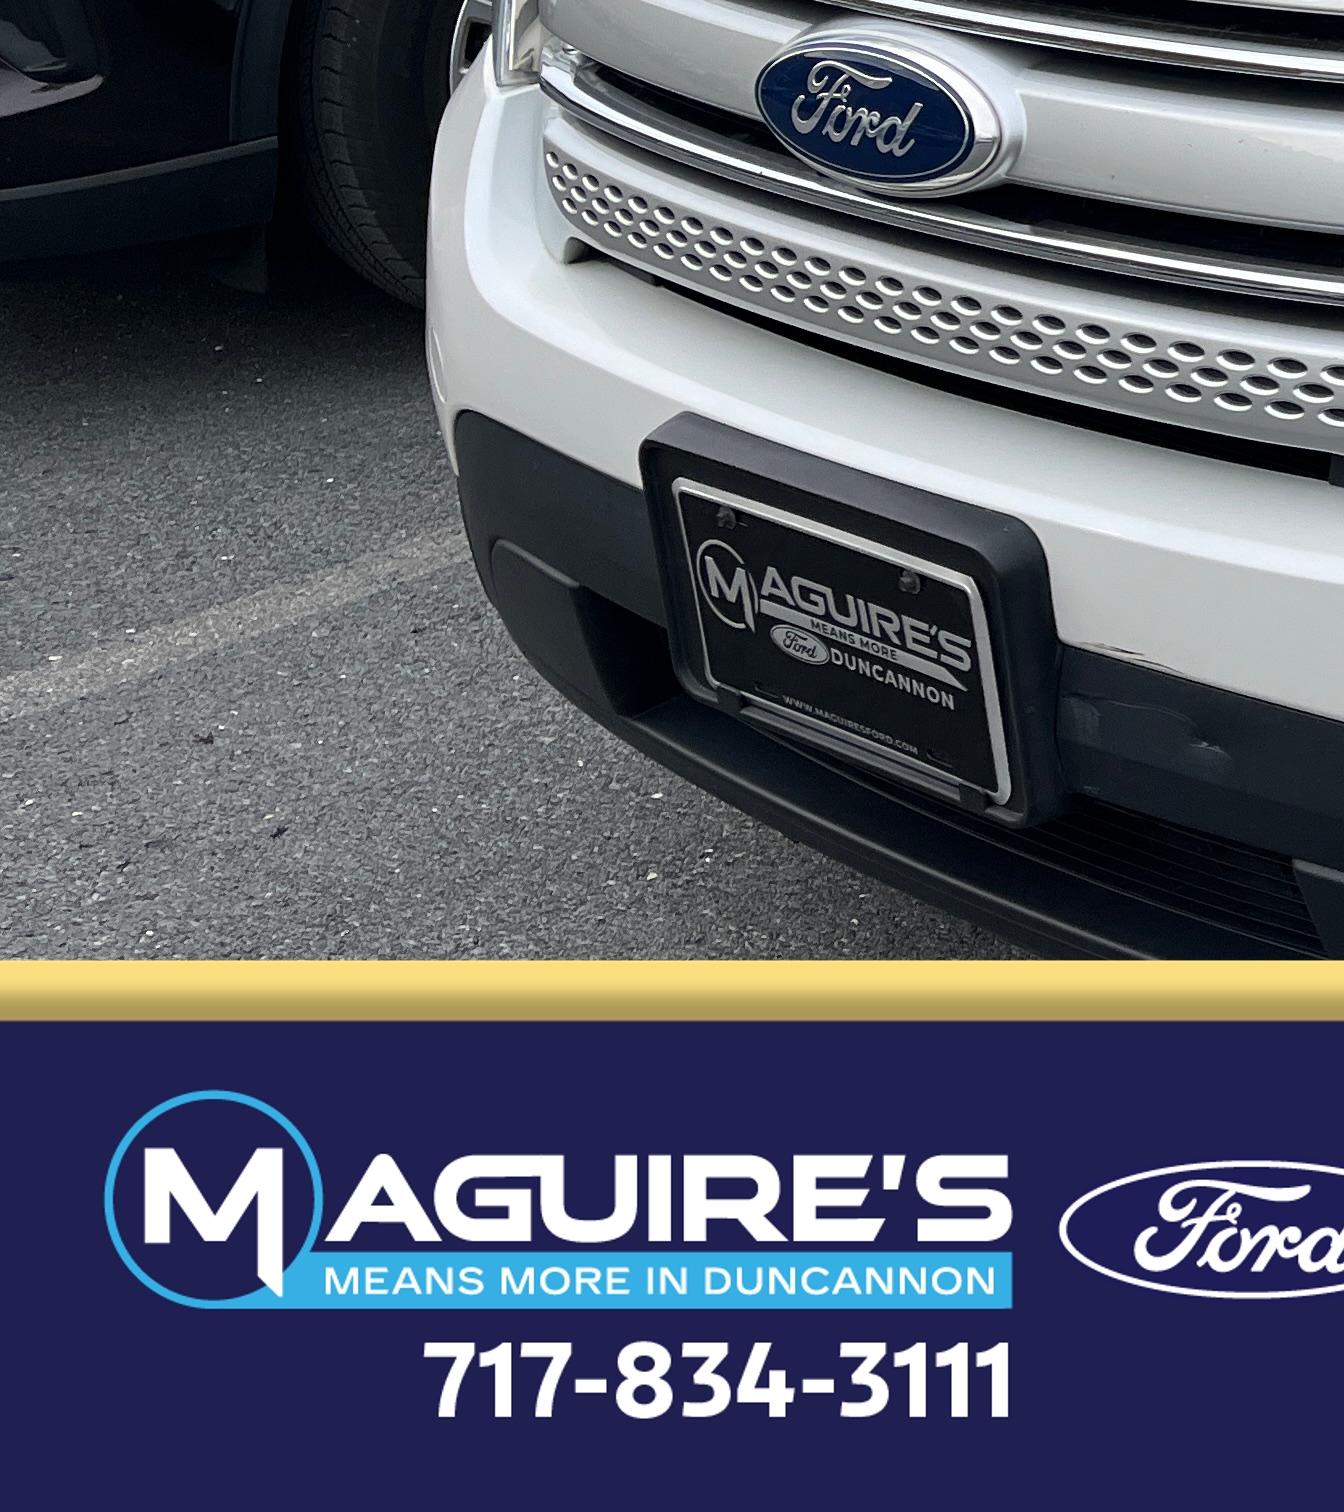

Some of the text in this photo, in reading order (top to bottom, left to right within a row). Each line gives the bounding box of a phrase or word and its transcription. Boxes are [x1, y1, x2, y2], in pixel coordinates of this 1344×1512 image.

[791, 60, 924, 158] Ford
[704, 554, 972, 674] MAGUIRE'S
[782, 630, 818, 660] Ford
[810, 619, 899, 661] MEANS MORE
[830, 648, 956, 711] DUNCANNON
[782, 694, 919, 755] WWW.MAGUIRESFORD.COM
